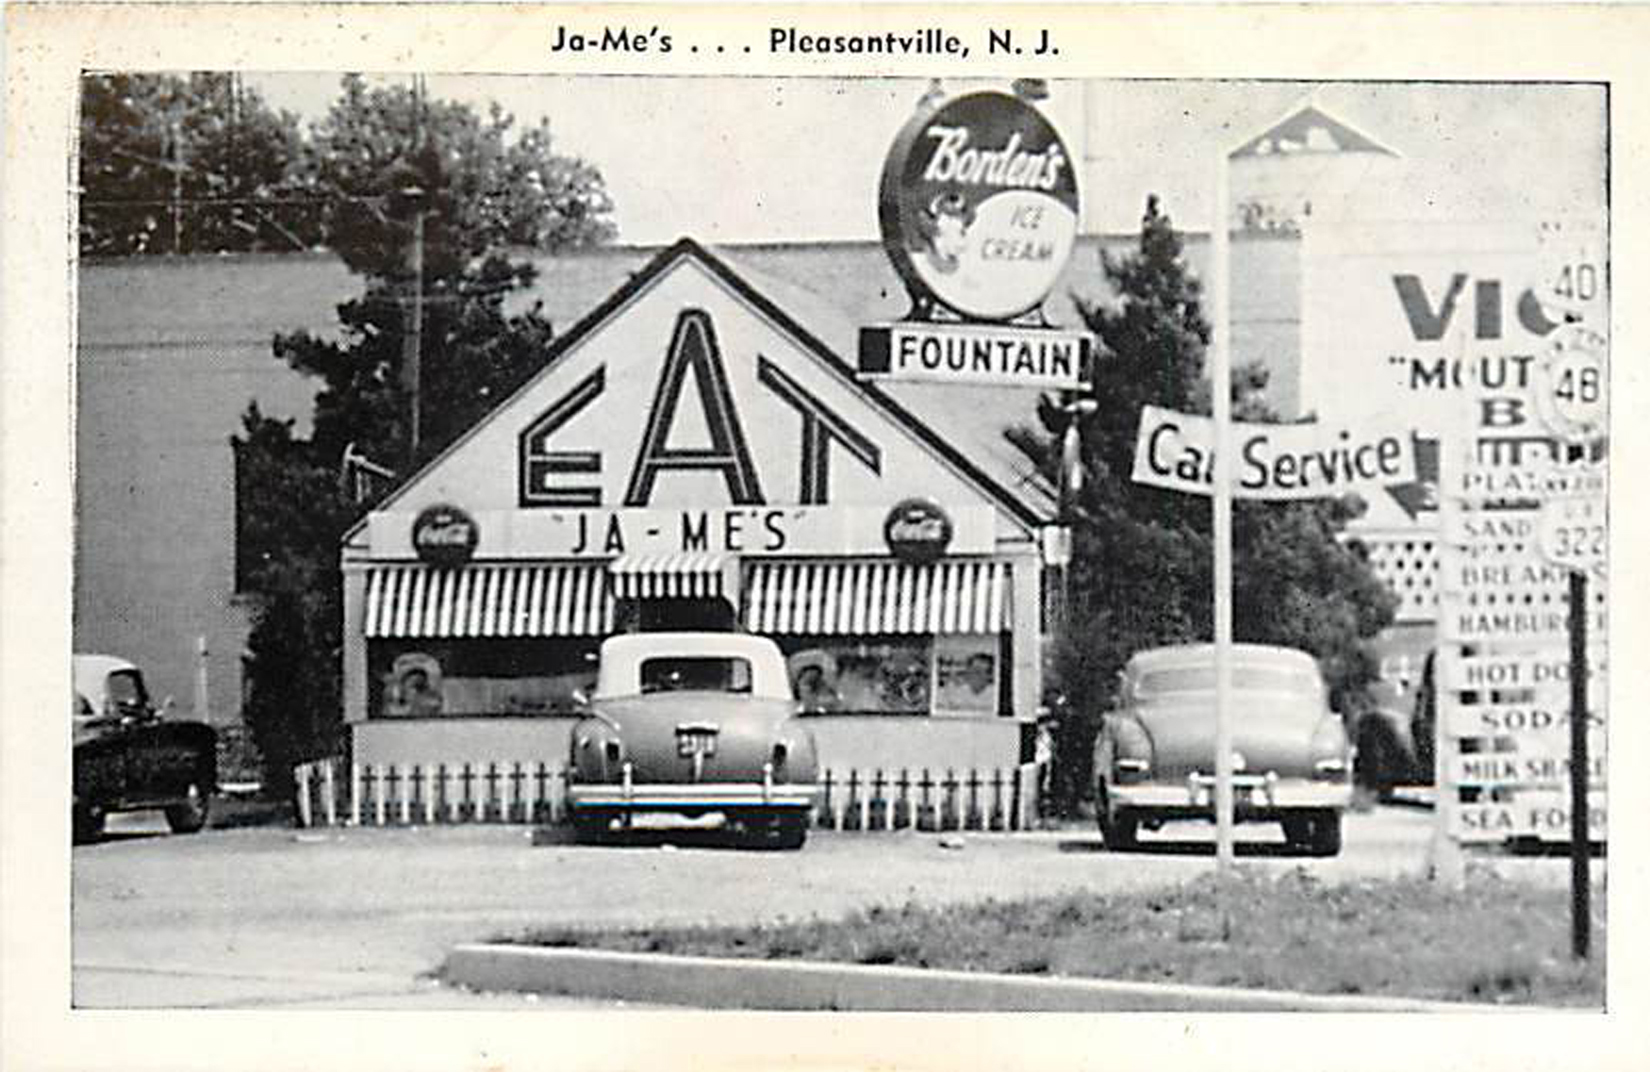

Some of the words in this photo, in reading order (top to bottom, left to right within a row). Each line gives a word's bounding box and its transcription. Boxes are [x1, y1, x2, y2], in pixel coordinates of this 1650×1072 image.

[924, 126, 1065, 189] Borden's
[1010, 205, 1046, 230] ICE
[980, 238, 1054, 261] CREAM
[1554, 263, 1597, 301] 40
[899, 335, 1073, 376] FOUNTAIN
[1554, 367, 1600, 403] 48
[518, 309, 881, 507] EAT
[1240, 430, 1402, 489] Service
[1555, 526, 1604, 557] 322
[1466, 664, 1519, 684] HOT
[1461, 810, 1513, 830] SEA
